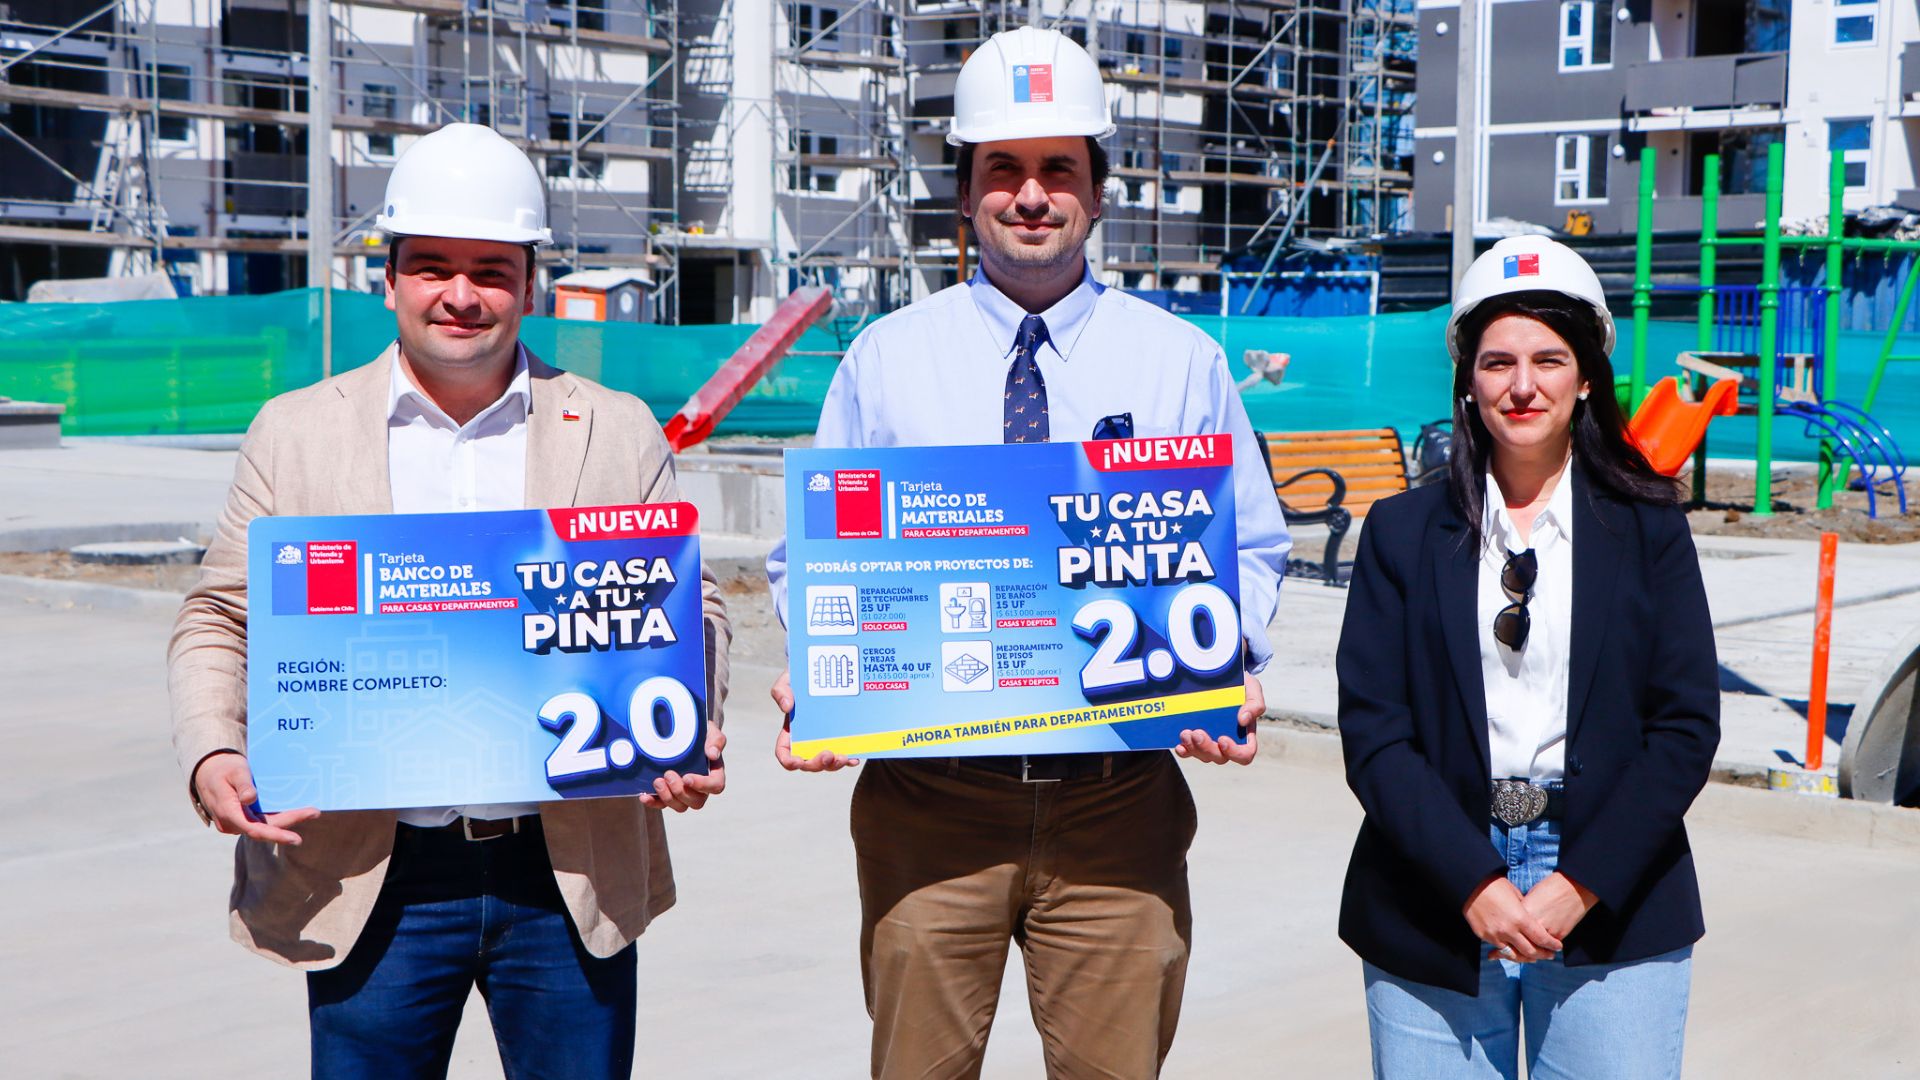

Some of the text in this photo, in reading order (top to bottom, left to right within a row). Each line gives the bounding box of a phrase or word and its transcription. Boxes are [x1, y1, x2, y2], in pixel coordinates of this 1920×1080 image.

[1104, 437, 1214, 469] ¡NUEVA!
[900, 481, 943, 494] Tarjeta
[901, 493, 987, 508] BANCO DE
[1050, 489, 1213, 522] TU CASA
[569, 508, 677, 539] ¡NUEVA!
[901, 509, 1004, 525] MATERIALES
[926, 529, 950, 537] CASAS
[958, 527, 1026, 536] DEPARTAMENTOS
[1104, 521, 1167, 543] A TU
[379, 552, 425, 566] Tarjeta
[805, 558, 1033, 573] PODRÁS OPTAR POR PROYECTOS DE:
[1058, 542, 1215, 584] PINTA
[379, 565, 473, 581] BANCO DE
[516, 557, 676, 590] TU CASA
[379, 581, 492, 599] MATERIALES
[860, 586, 913, 595] REPARACIÓN
[995, 582, 1048, 592] REPARACIÓN
[1008, 590, 1036, 599] BAÑOS
[382, 604, 404, 613] PARA
[406, 603, 432, 612] CASAS
[441, 600, 515, 611] DEPARTAMENTOS
[569, 588, 630, 609] A TU
[996, 600, 1025, 609] 15 UF
[861, 603, 890, 612] 25 UF
[524, 608, 677, 649] PINTA
[1071, 582, 1241, 690] 2.0
[996, 643, 1063, 651] MEJORAMIENTO
[277, 658, 345, 674] REGIÓN:
[863, 663, 931, 672] HASTA 40 UF
[997, 660, 1026, 669] 15 UF
[277, 676, 447, 693] NOMBRE COMPLETO:
[277, 718, 314, 731] RUT:
[537, 675, 698, 780] 2.0
[902, 701, 1166, 746] ¡AHORA TAMBIÉN PARA DEPARTAMENTOS!
